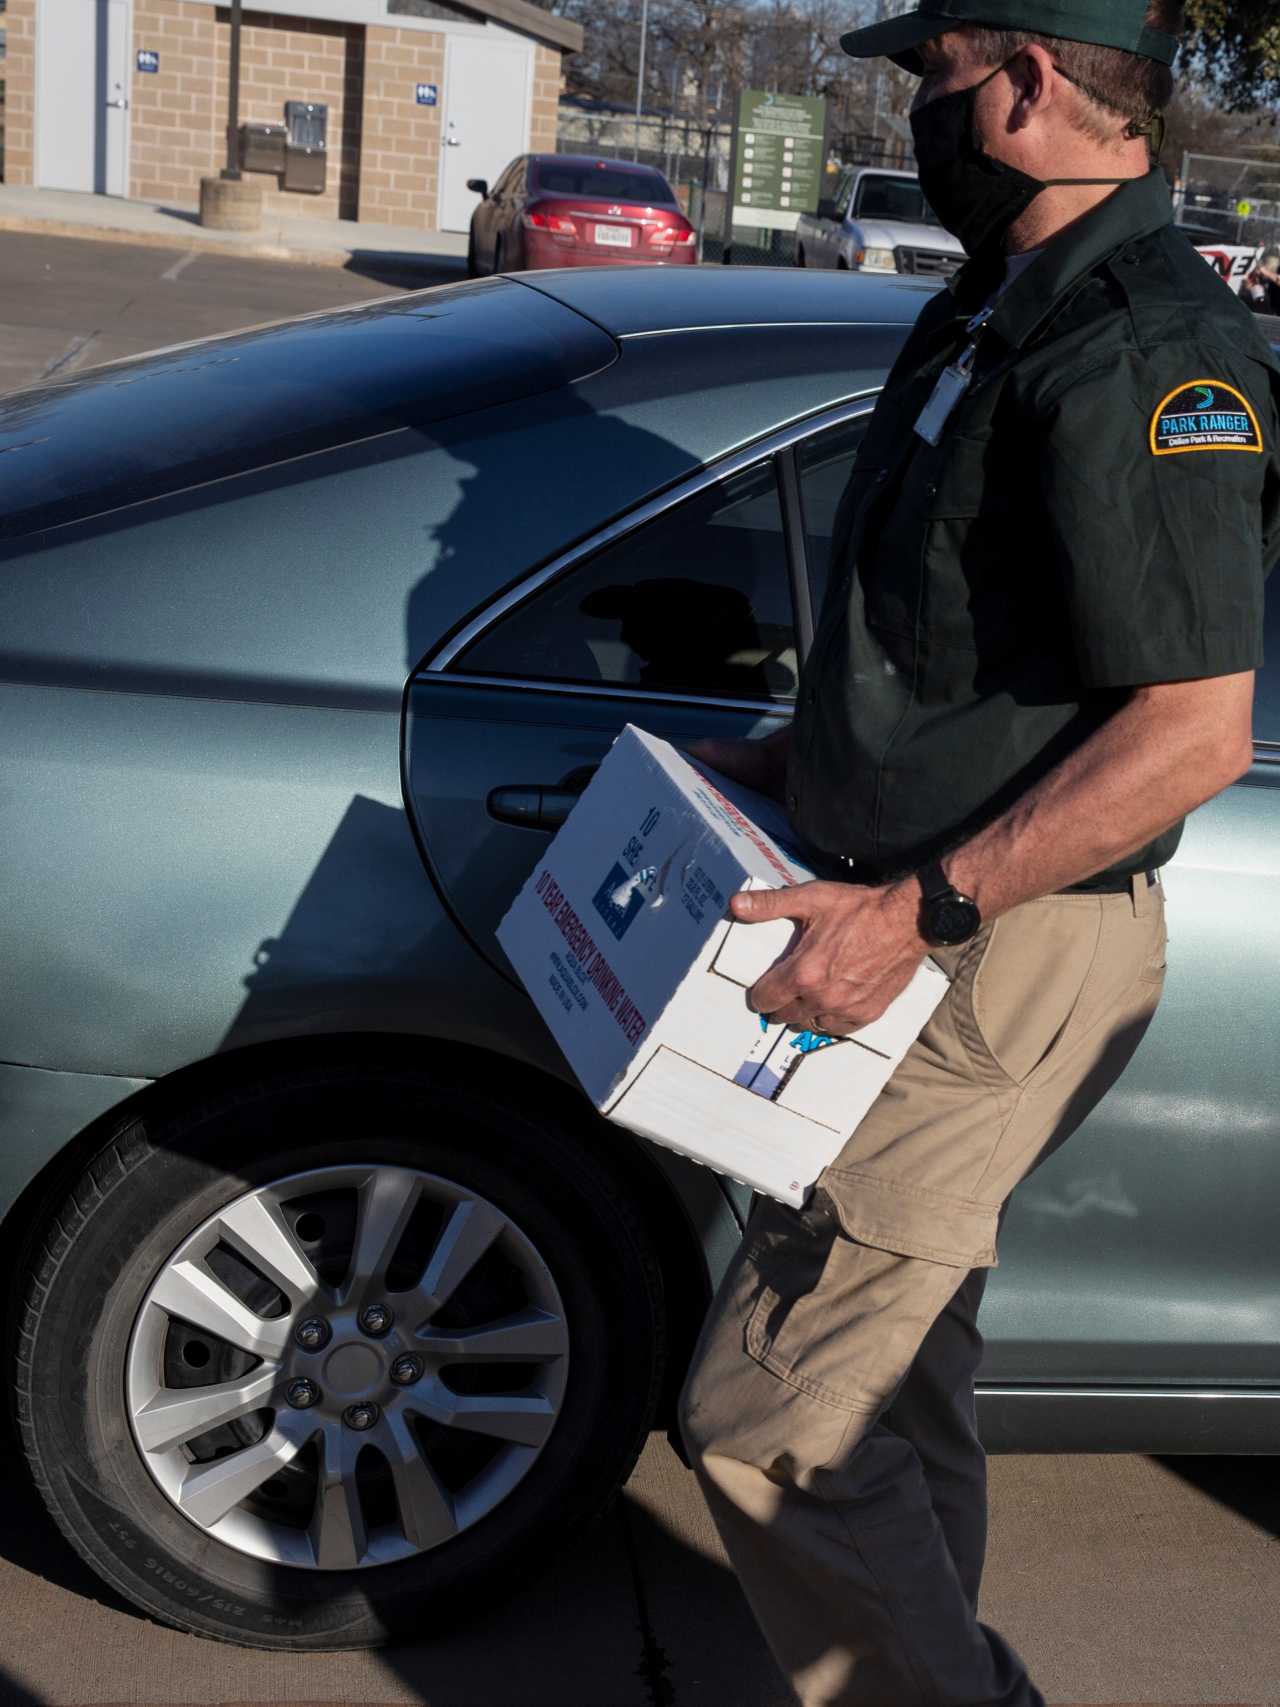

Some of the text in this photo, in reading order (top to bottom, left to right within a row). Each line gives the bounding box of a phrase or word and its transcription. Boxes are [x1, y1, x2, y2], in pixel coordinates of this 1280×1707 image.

[1162, 415, 1249, 434] PARK RANGER
[640, 806, 661, 837] 10
[535, 869, 553, 895] 10
[541, 880, 565, 917] YEAR
[553, 900, 597, 967] EMERGENCY
[586, 953, 626, 1013] DRINKING
[614, 995, 647, 1048] WATER
